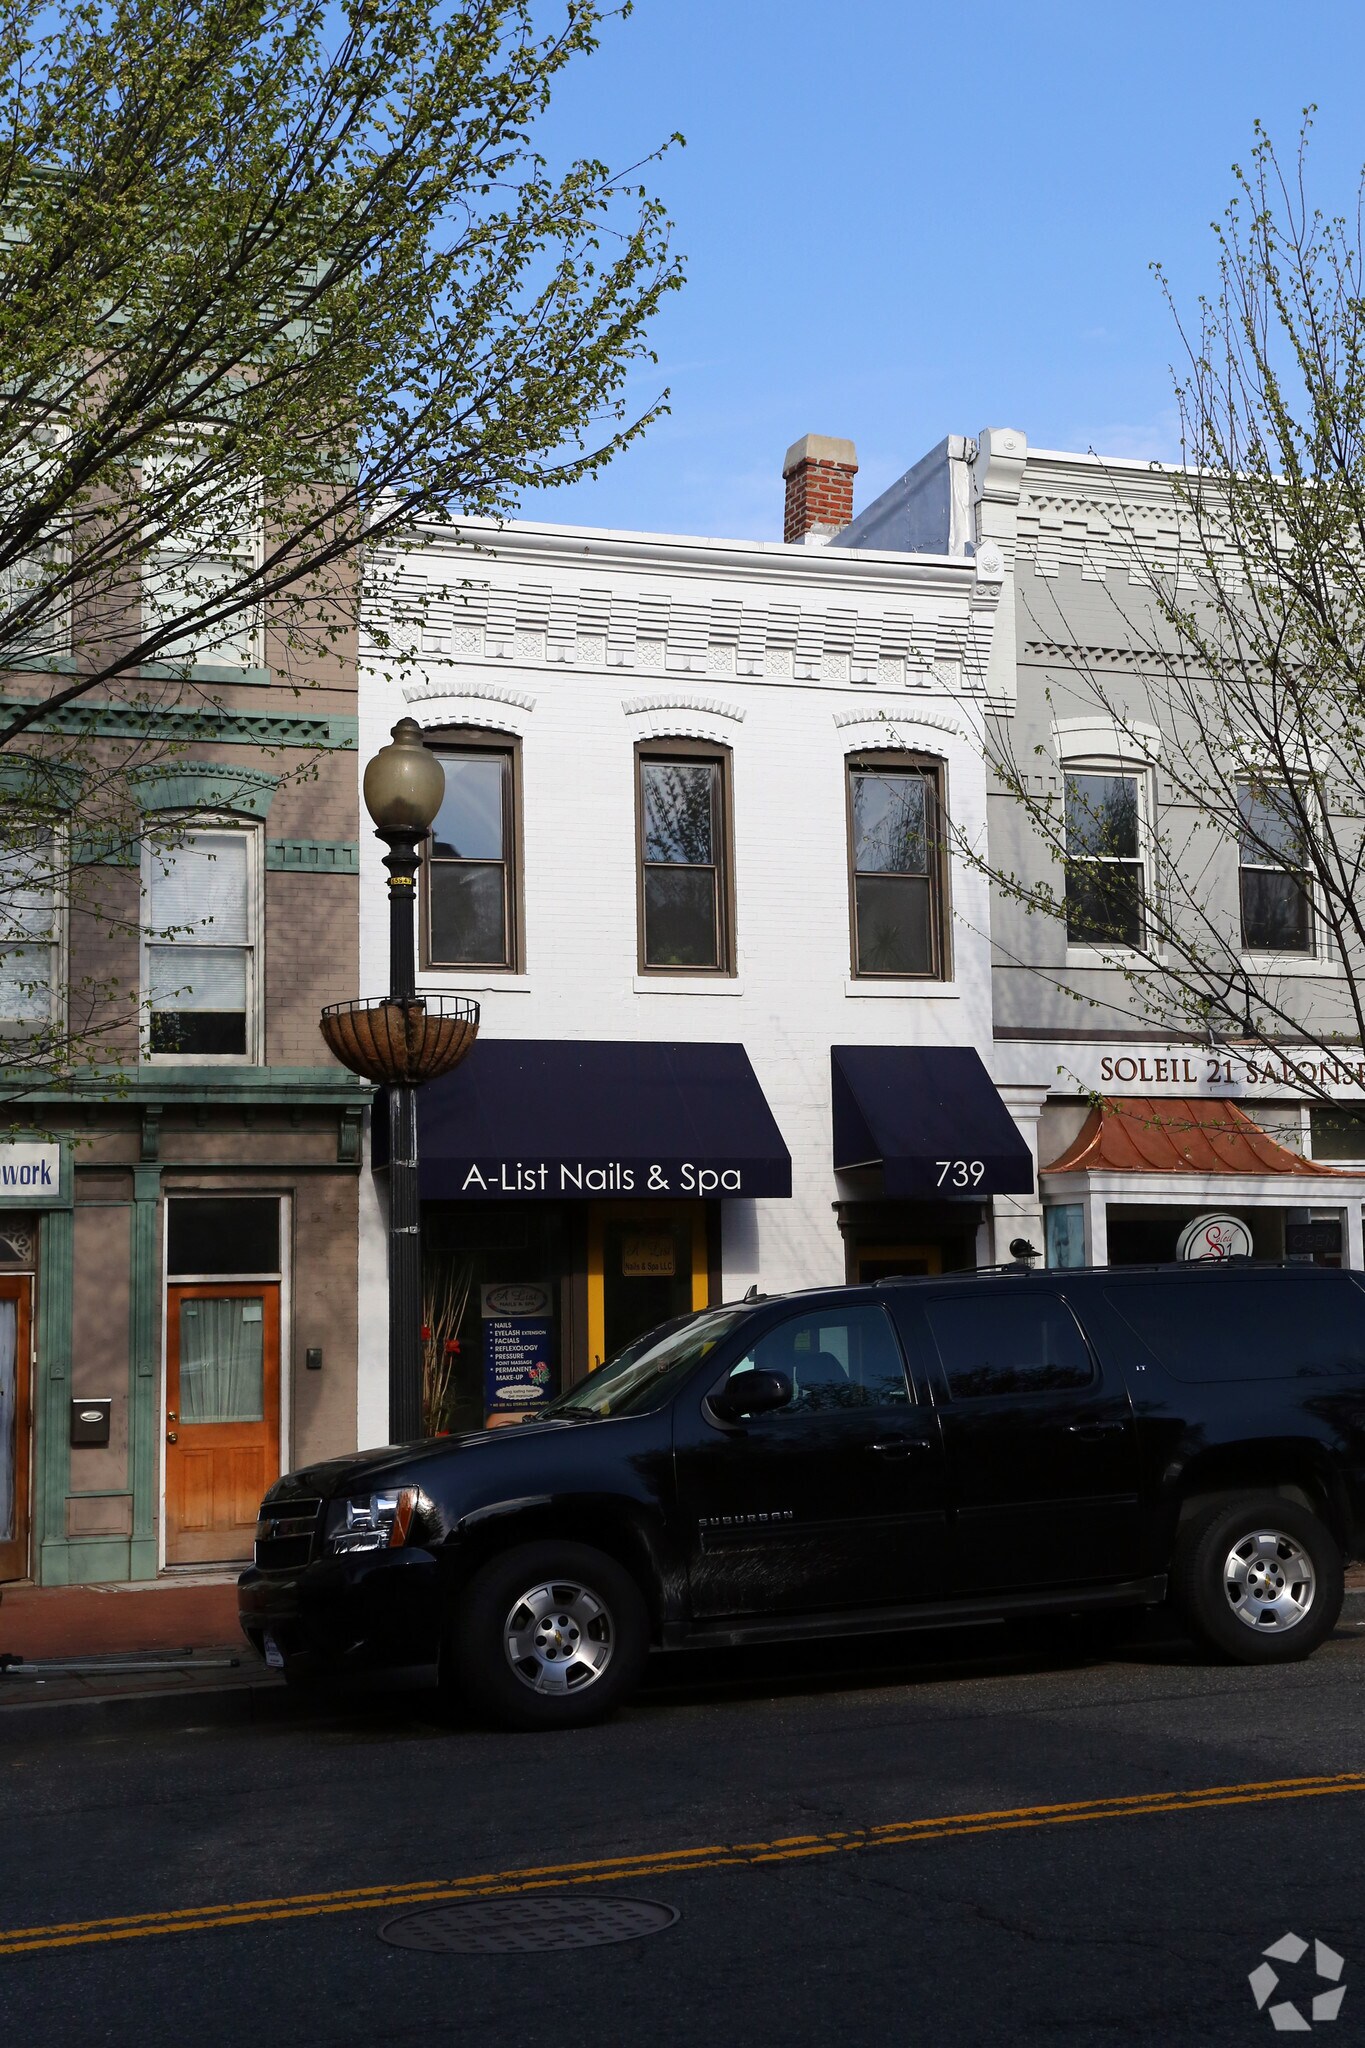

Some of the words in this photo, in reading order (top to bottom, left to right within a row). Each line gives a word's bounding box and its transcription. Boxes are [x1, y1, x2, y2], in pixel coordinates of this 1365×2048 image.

[1101, 1057, 1197, 1082] SOLEIL
[1206, 1059, 1235, 1083] 21
[461, 1163, 549, 1190] A-List
[560, 1162, 635, 1190] Nails
[647, 1164, 670, 1190] &
[680, 1163, 741, 1196] Spa
[935, 1161, 985, 1187] 739
[1293, 1233, 1336, 1247] OPEN
[647, 1262, 659, 1272] Spa
[698, 1510, 793, 1527] SUBURBAN
